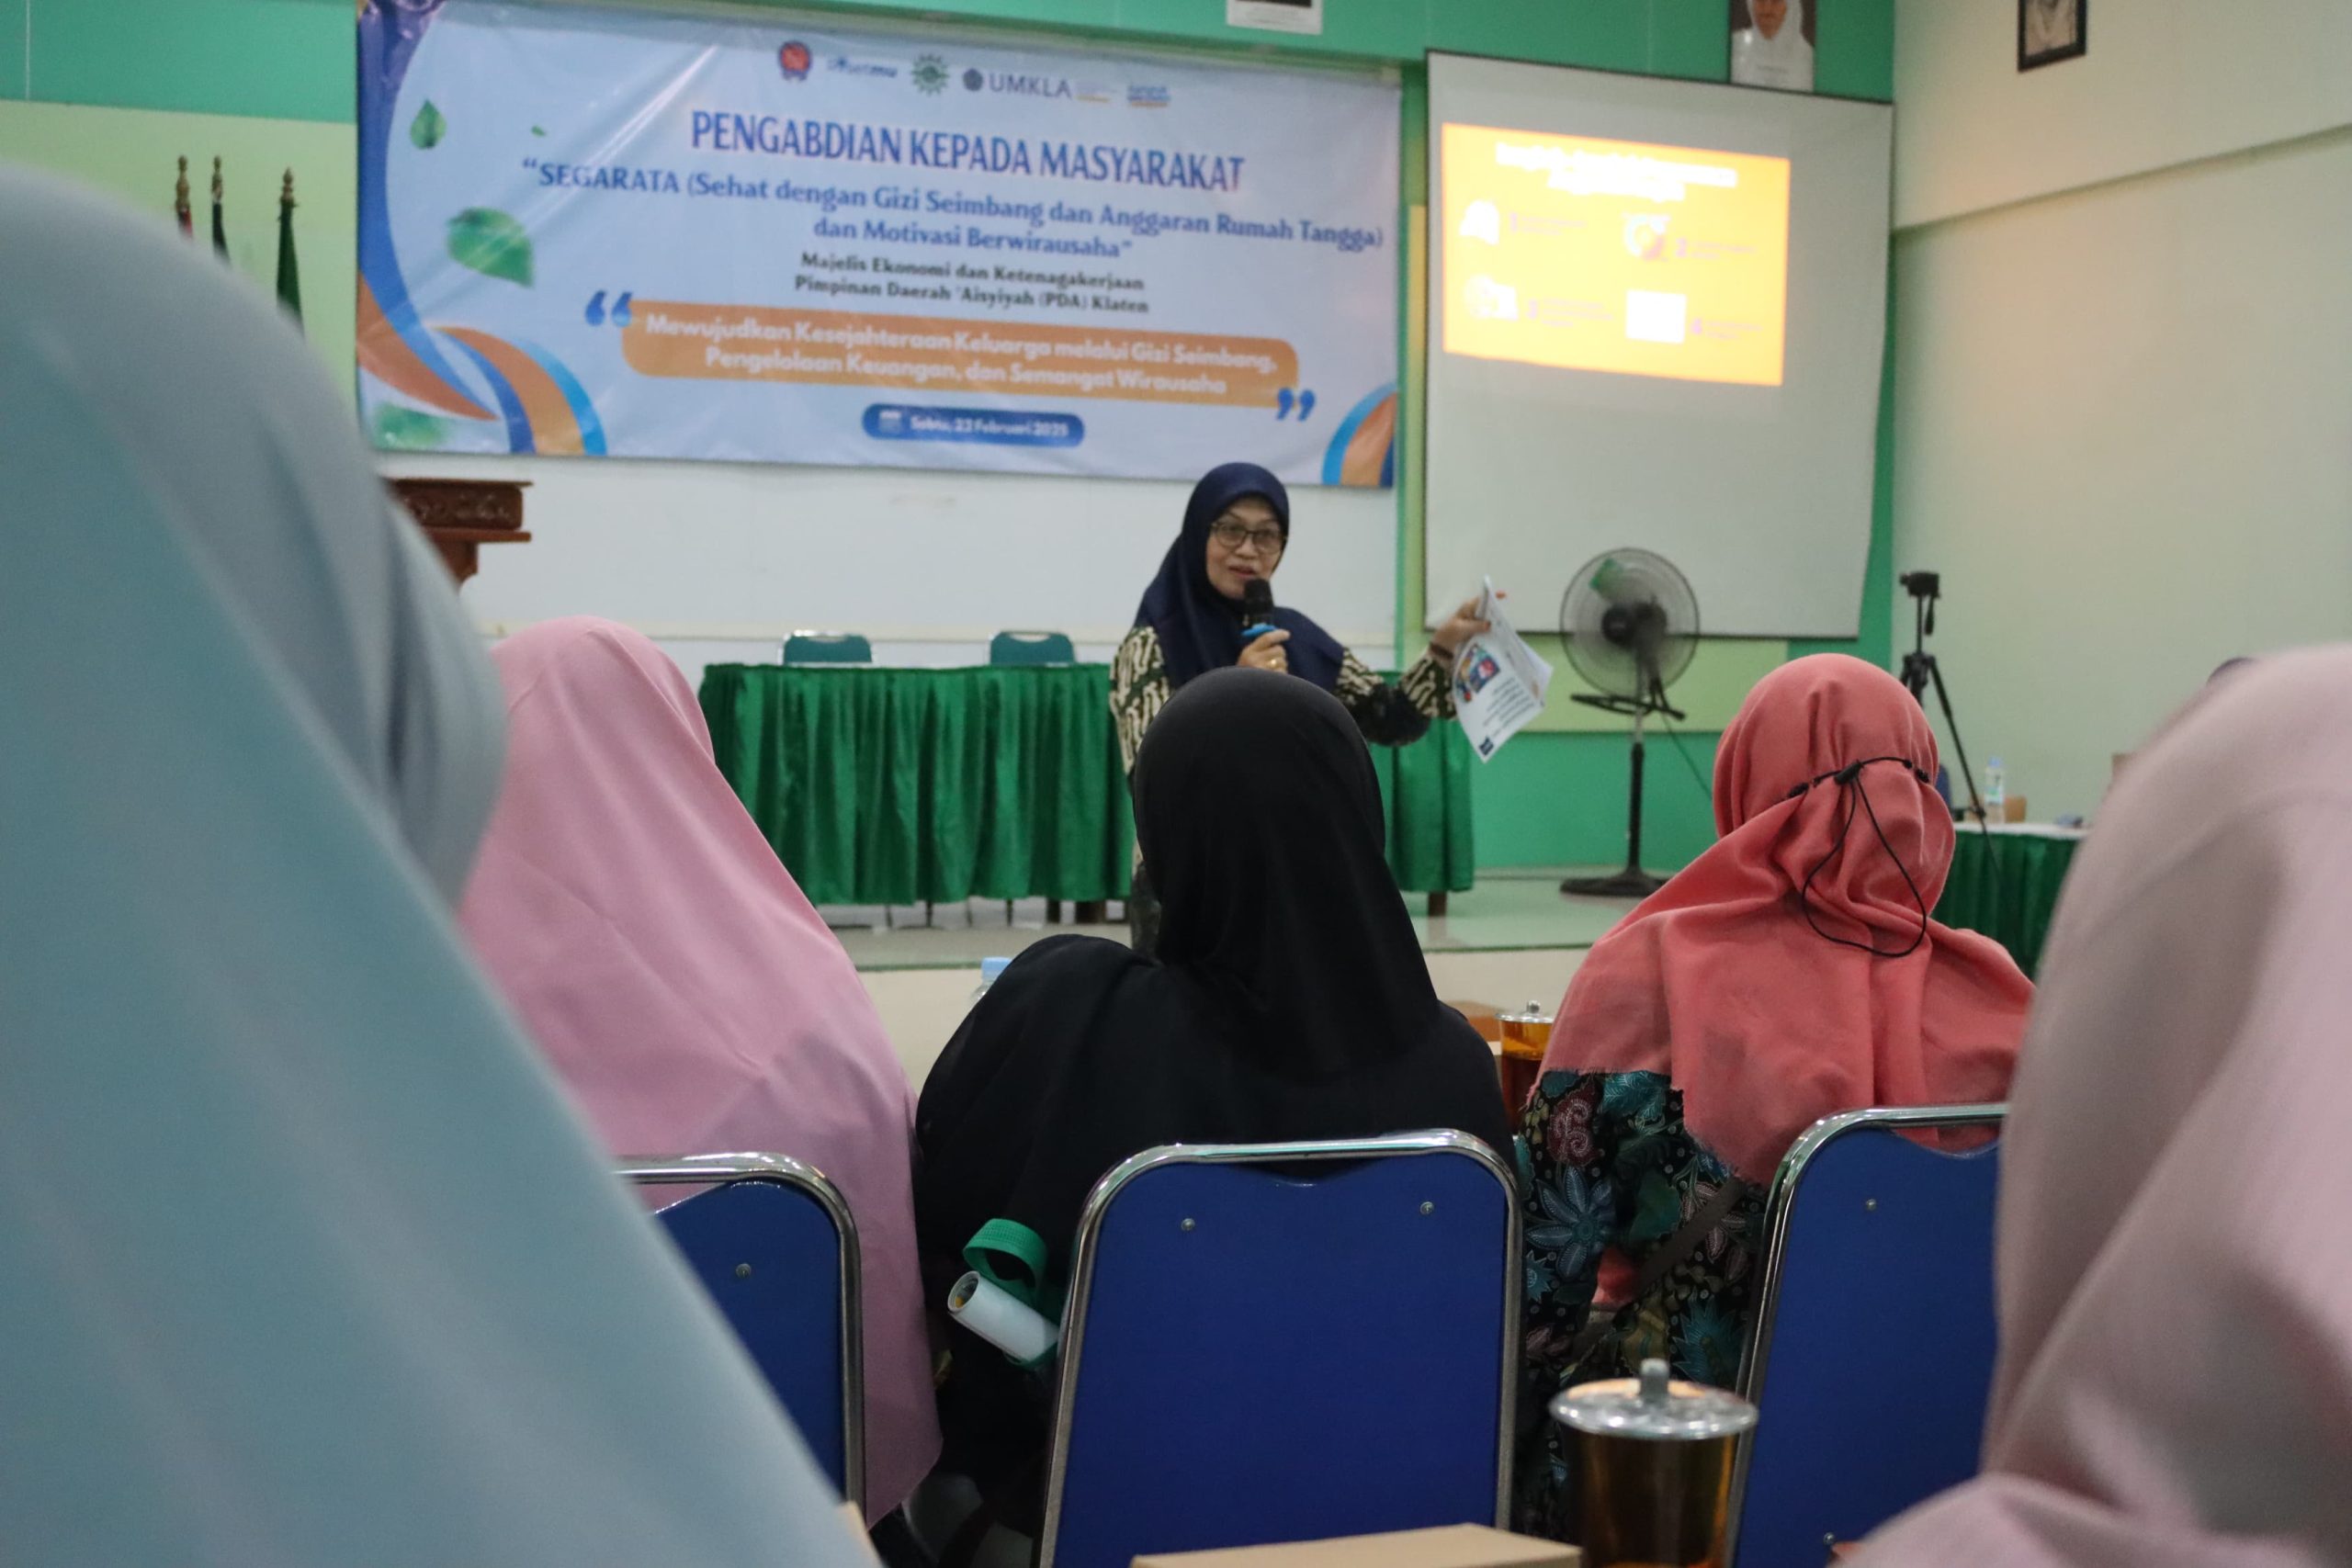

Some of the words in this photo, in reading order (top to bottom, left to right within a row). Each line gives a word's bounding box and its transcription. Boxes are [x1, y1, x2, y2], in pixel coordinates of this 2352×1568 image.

[989, 73, 1072, 100] UMKLA
[692, 110, 900, 164] PENGABDIAN
[910, 130, 1031, 175] KEPADA
[1040, 141, 1244, 192] MASYARAKAT
[688, 172, 768, 199] (Sehat
[775, 180, 865, 212] dengan
[875, 186, 920, 210] Gizi
[925, 190, 1044, 228] Seimbang
[1049, 201, 1092, 224] dan
[1100, 205, 1209, 236] Anggaran
[1216, 214, 1293, 241] Rumah
[1300, 221, 1384, 253] Tangga)
[814, 218, 856, 239] dan
[864, 220, 961, 246] Motivasi
[801, 252, 866, 276] Majelis
[872, 257, 950, 278] Ekonomi
[956, 265, 989, 281] dan
[994, 265, 1144, 291] Ketenagakerjaan
[796, 276, 881, 297] Pimpinan
[888, 282, 951, 300] Daerah
[1040, 293, 1088, 310] (PDA)
[1091, 298, 1149, 314] Klaten
[647, 314, 790, 343] Mewujudkan
[795, 321, 951, 350] Kesejahteraan
[953, 332, 1050, 359] Keluarga
[1056, 338, 1128, 361] melalui
[1131, 343, 1170, 364] Gizi
[1173, 344, 1278, 374] Seimbang,
[706, 346, 841, 374] Pengelolaan
[846, 354, 962, 382] Keuangan,
[966, 364, 1006, 382] dan
[1011, 364, 1113, 392] Semangat
[1117, 368, 1227, 395] Wirausaha
[975, 419, 1031, 435] Februari
